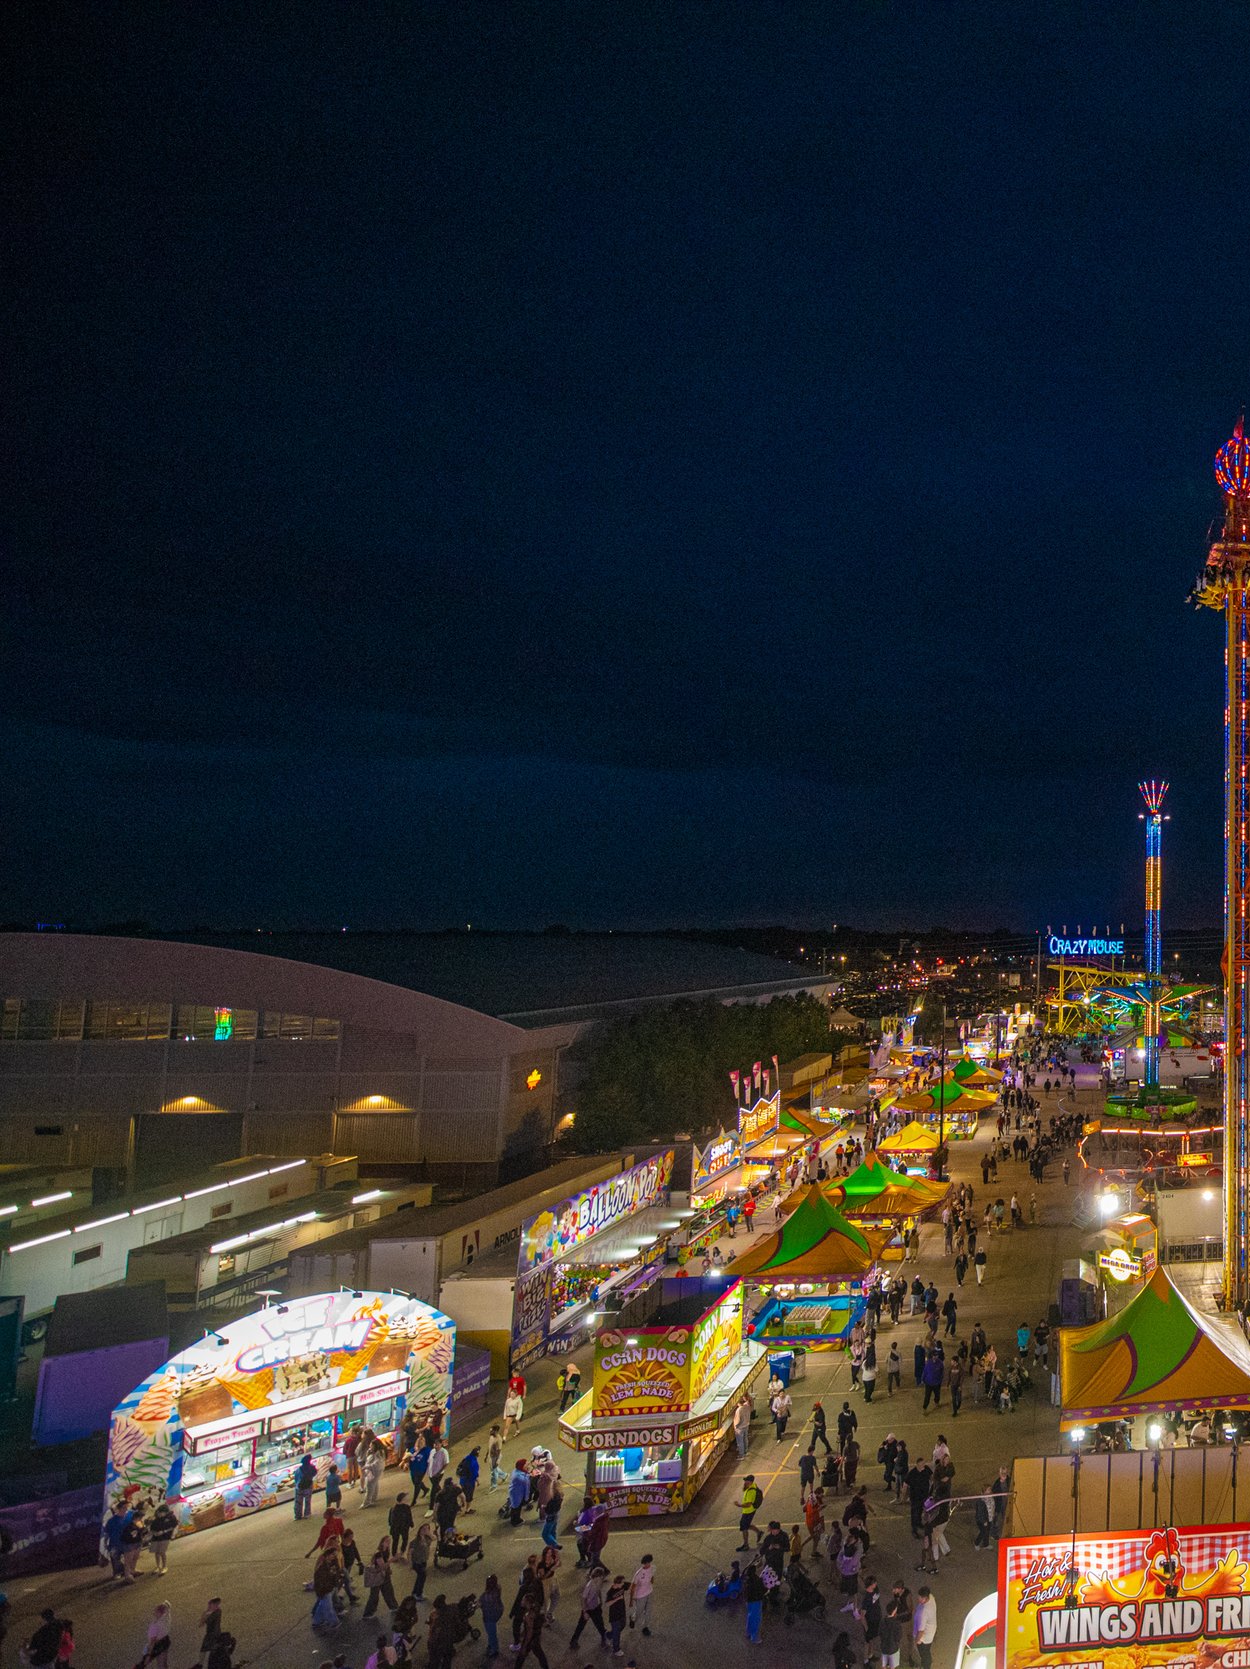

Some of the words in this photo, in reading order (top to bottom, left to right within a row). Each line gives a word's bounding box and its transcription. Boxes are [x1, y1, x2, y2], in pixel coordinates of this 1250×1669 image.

[1050, 936, 1087, 955] CRAZY
[1087, 939, 1124, 955] MOUSE
[579, 1174, 636, 1231] BALLOON
[636, 1164, 659, 1200] POP
[267, 1302, 331, 1337] ICE
[241, 1319, 372, 1371] CREAM
[600, 1348, 643, 1371] CORN
[646, 1347, 687, 1367] DOGS
[581, 1428, 673, 1449] CORNDOGS
[1023, 1556, 1061, 1585] Hot
[1040, 1603, 1138, 1647] WINGS
[1140, 1598, 1203, 1640] AND
